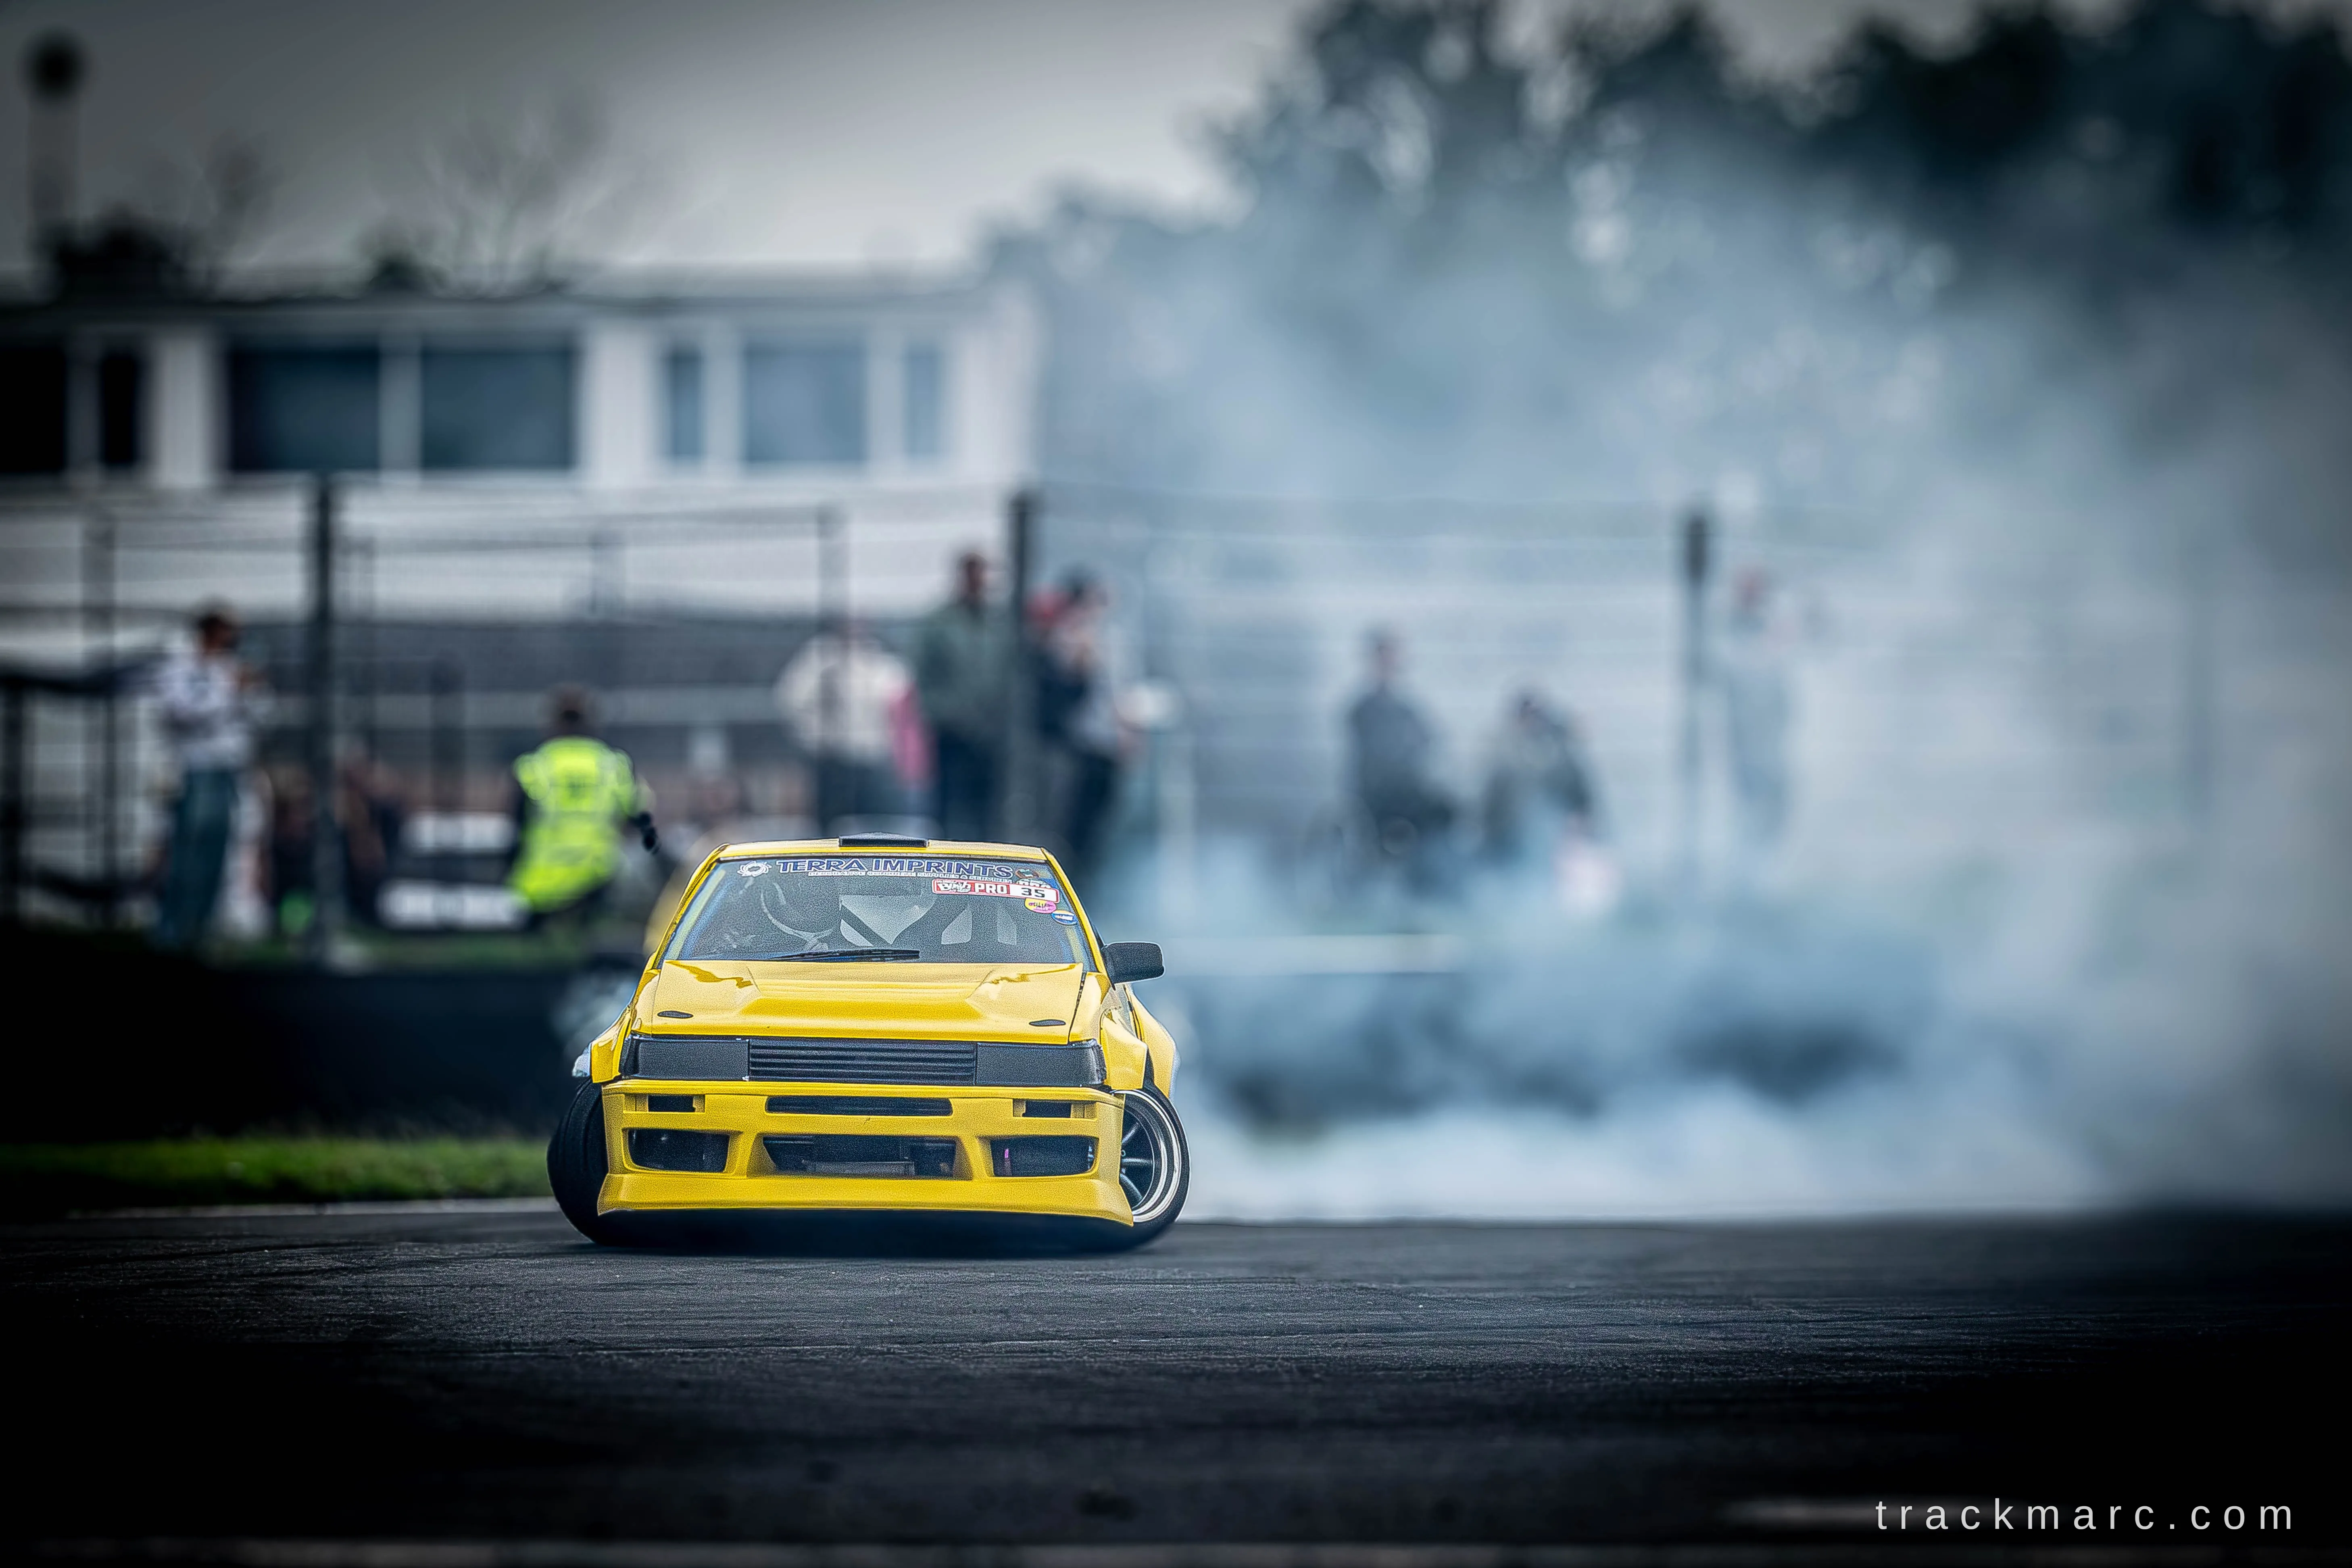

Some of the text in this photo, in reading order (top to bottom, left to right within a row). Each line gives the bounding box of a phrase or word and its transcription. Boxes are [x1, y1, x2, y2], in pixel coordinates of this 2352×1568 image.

[776, 858, 868, 873] TERRA
[872, 858, 1013, 879] IMPRINTS
[974, 882, 1008, 894] PRO
[1021, 887, 1045, 898] 35
